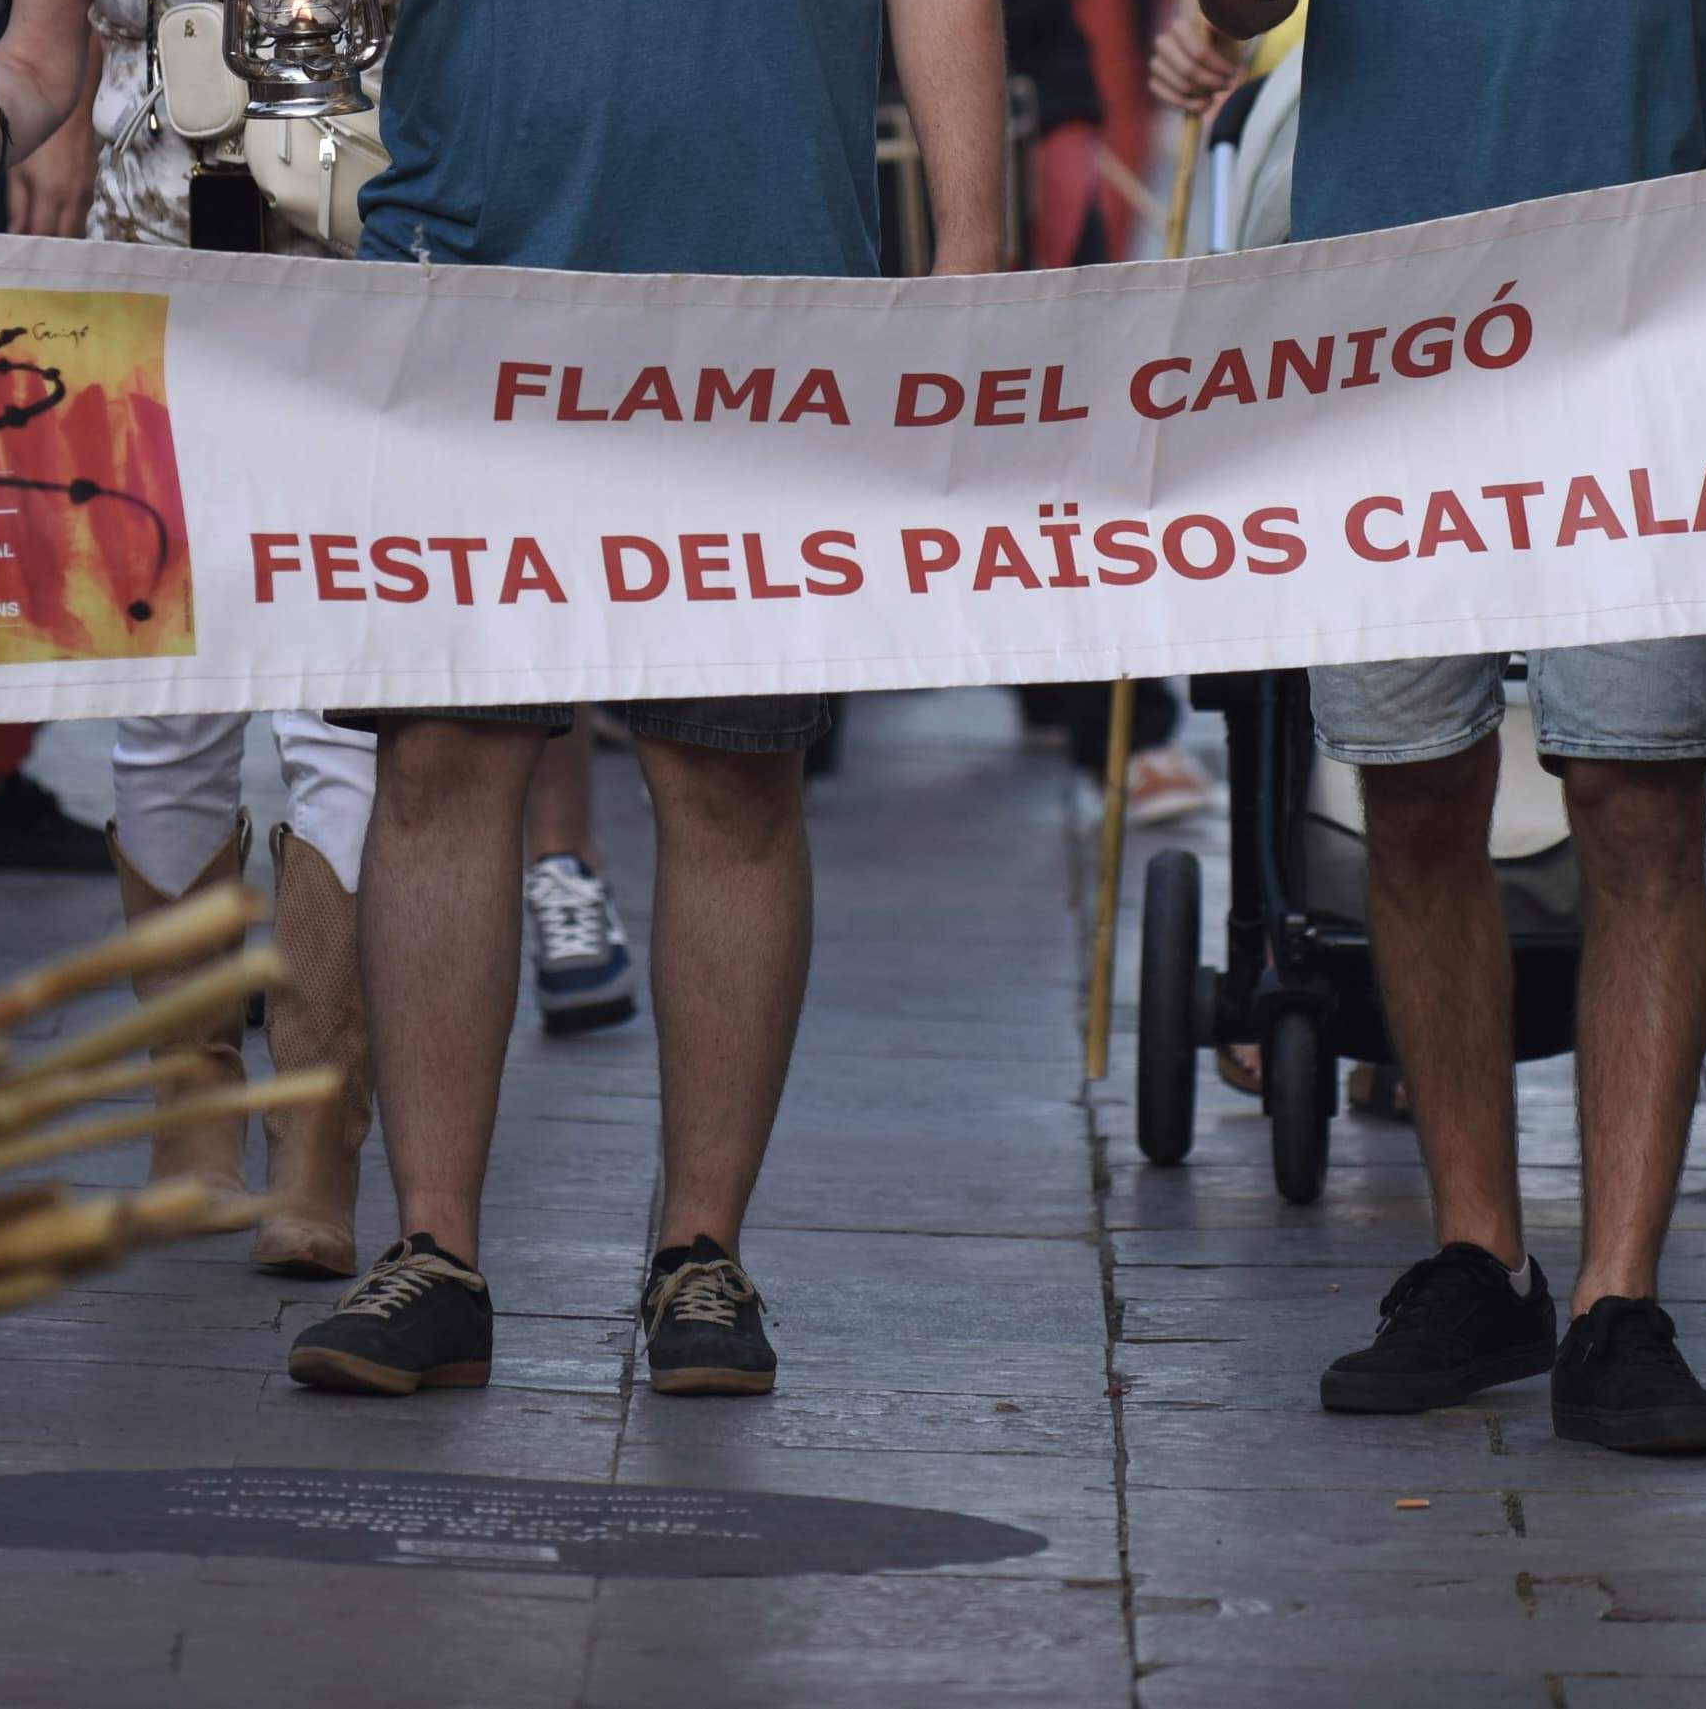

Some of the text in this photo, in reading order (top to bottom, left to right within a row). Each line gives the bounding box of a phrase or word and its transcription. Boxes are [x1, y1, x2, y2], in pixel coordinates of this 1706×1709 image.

[494, 280, 1534, 428] FLAMA DEL CANIGÓ
[249, 531, 568, 607] FESTA
[601, 529, 865, 603] DELS
[900, 502, 1307, 595] PAÏSOS
